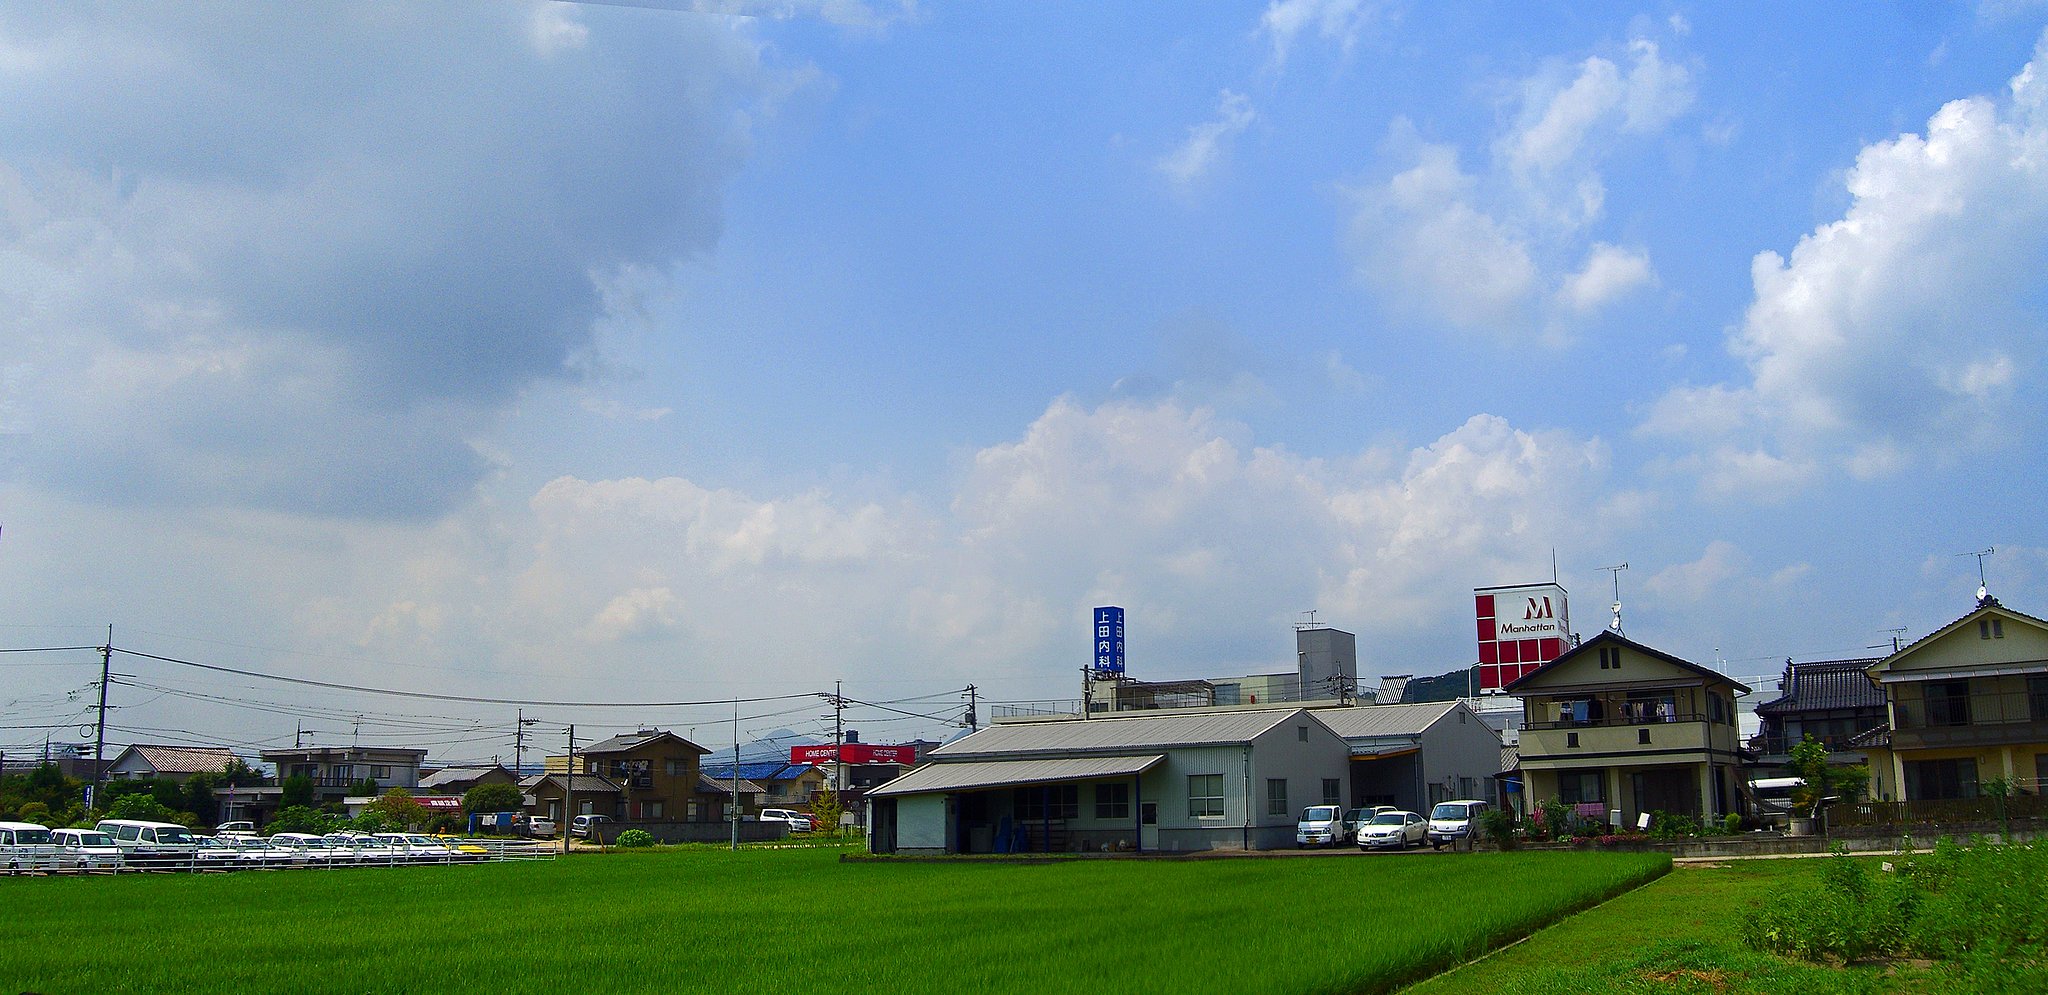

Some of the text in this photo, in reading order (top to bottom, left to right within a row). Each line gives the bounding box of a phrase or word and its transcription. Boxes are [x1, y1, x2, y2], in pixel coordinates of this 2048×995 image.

[1501, 623, 1555, 634] Manhattan
[1098, 611, 1110, 668] 上田内科
[805, 750, 819, 758] HOME
